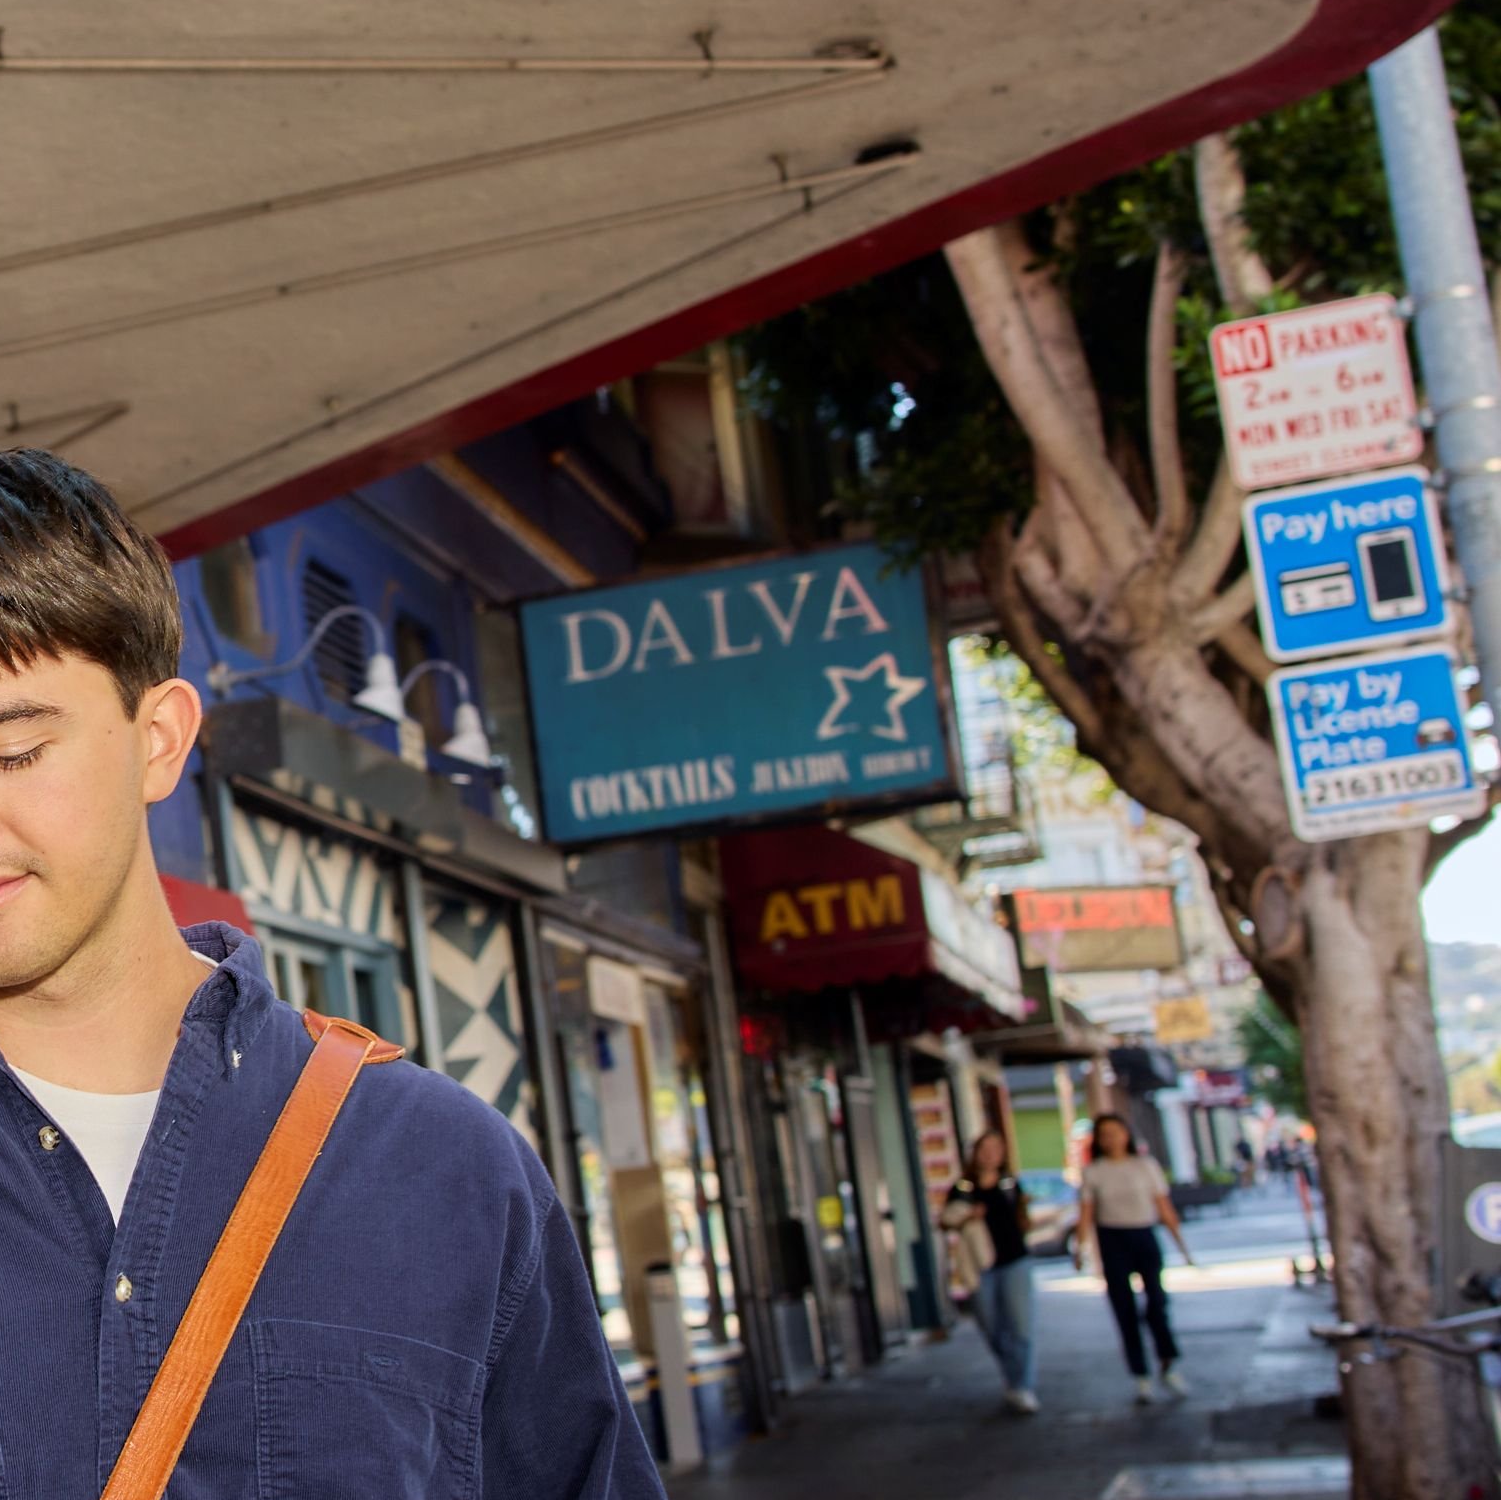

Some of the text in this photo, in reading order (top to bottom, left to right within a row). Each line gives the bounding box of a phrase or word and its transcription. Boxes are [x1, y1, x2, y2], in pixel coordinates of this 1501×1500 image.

[1218, 313, 1387, 374] NO PARKING
[1238, 395, 1402, 447] MON WED FRI SAT
[1261, 494, 1417, 544] Pay here
[560, 566, 890, 684] DALVA
[1287, 668, 1402, 712] Pay by
[1293, 699, 1419, 740] License
[1297, 735, 1387, 770] Plate
[569, 755, 737, 821] COCKTAILS
[761, 874, 905, 943] ATM
